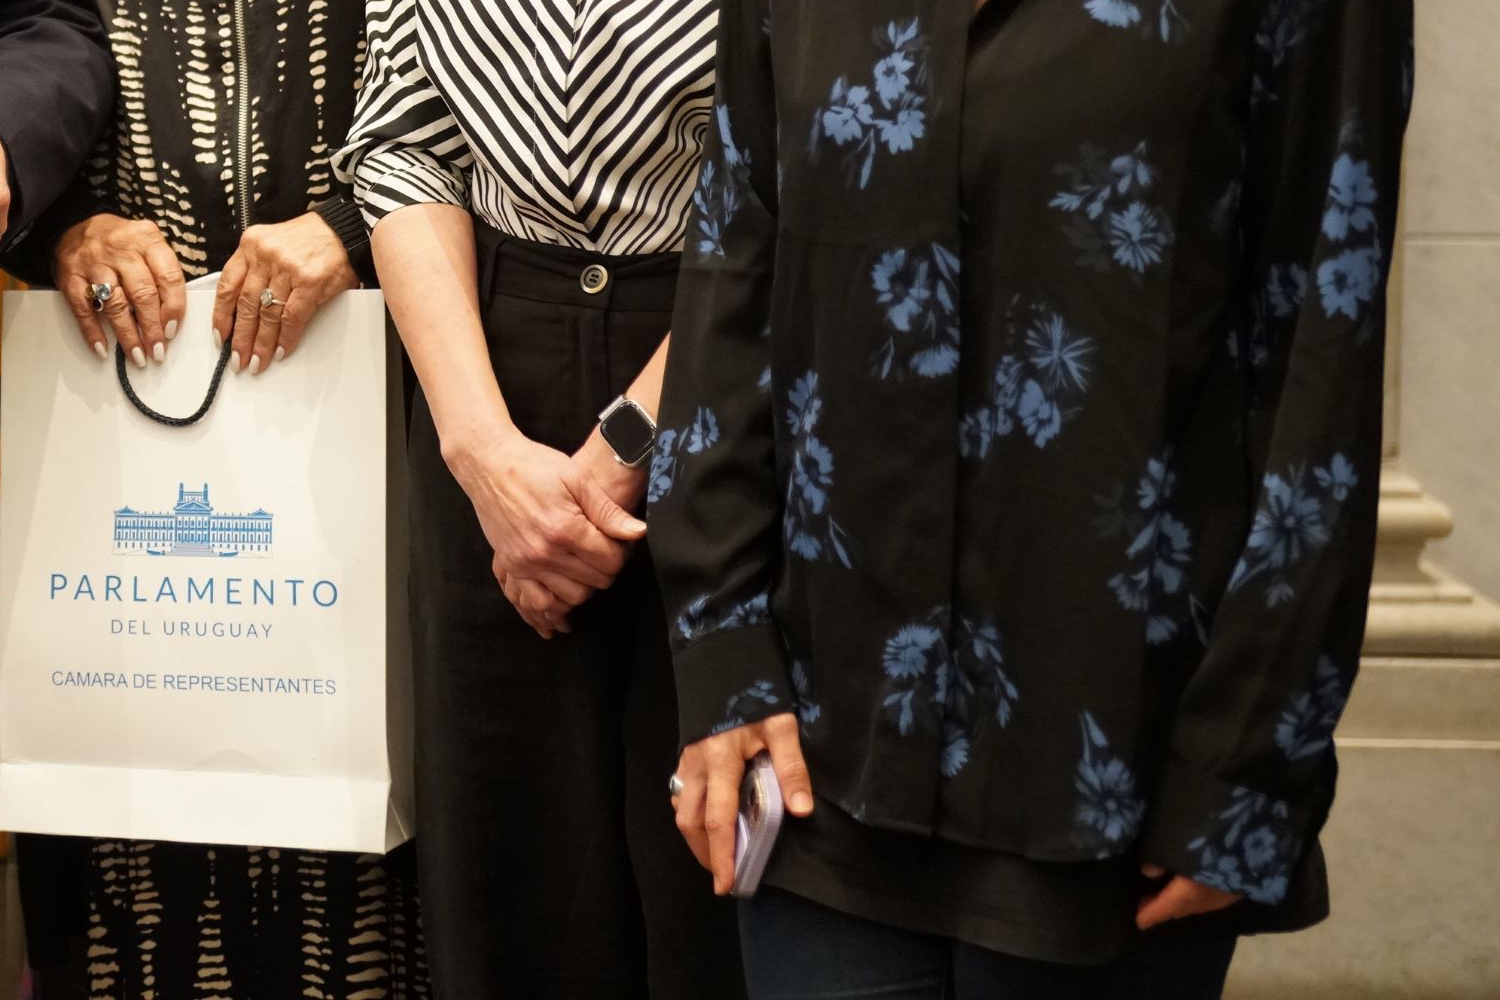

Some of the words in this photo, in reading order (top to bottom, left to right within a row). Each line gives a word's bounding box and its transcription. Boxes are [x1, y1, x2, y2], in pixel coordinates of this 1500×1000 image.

[50, 574, 338, 607] PARLAMENTO
[111, 619, 151, 635] DEL
[163, 621, 273, 638] URUGUAY
[52, 671, 128, 688] CAMARA
[133, 674, 157, 689] DE
[163, 675, 337, 695] REPRESENTANTES
